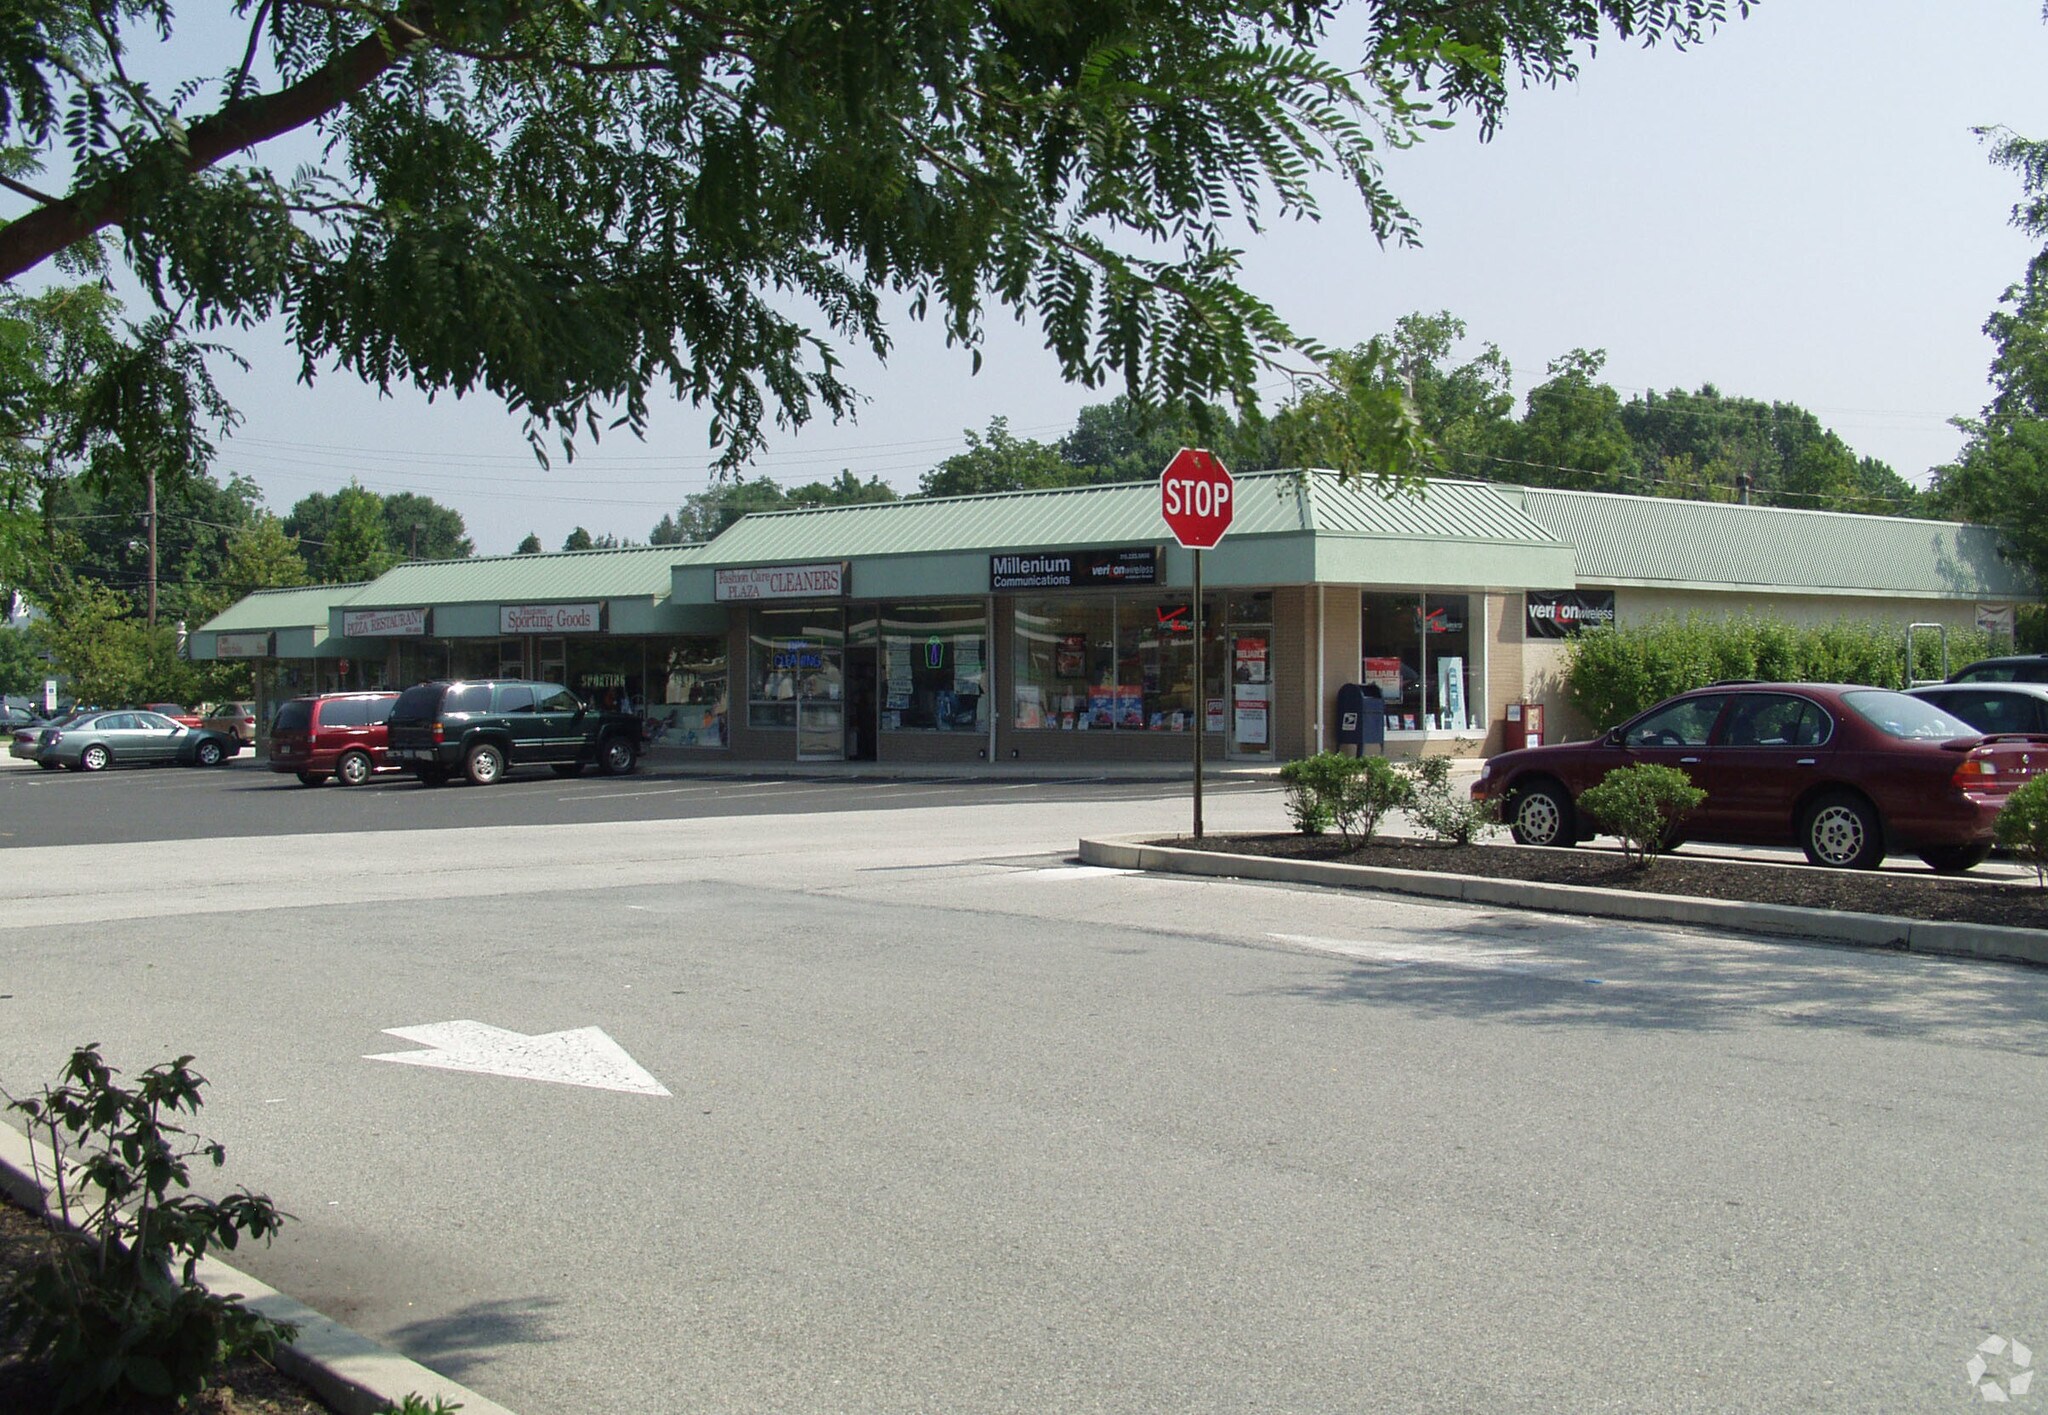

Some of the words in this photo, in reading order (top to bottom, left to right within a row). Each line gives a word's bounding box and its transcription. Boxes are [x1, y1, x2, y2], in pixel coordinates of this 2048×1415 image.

[1165, 478, 1230, 518] STOP
[993, 555, 1071, 575] Millenium
[719, 570, 749, 585] Fashion
[750, 569, 770, 583] Care
[770, 570, 839, 593] CLEANERS
[993, 575, 1071, 588] Communications
[728, 585, 760, 599] PLAZA
[347, 621, 369, 636] PIZZA
[371, 611, 423, 632] RESTAURANT
[508, 611, 553, 633] Sporting
[556, 608, 591, 627] Goods
